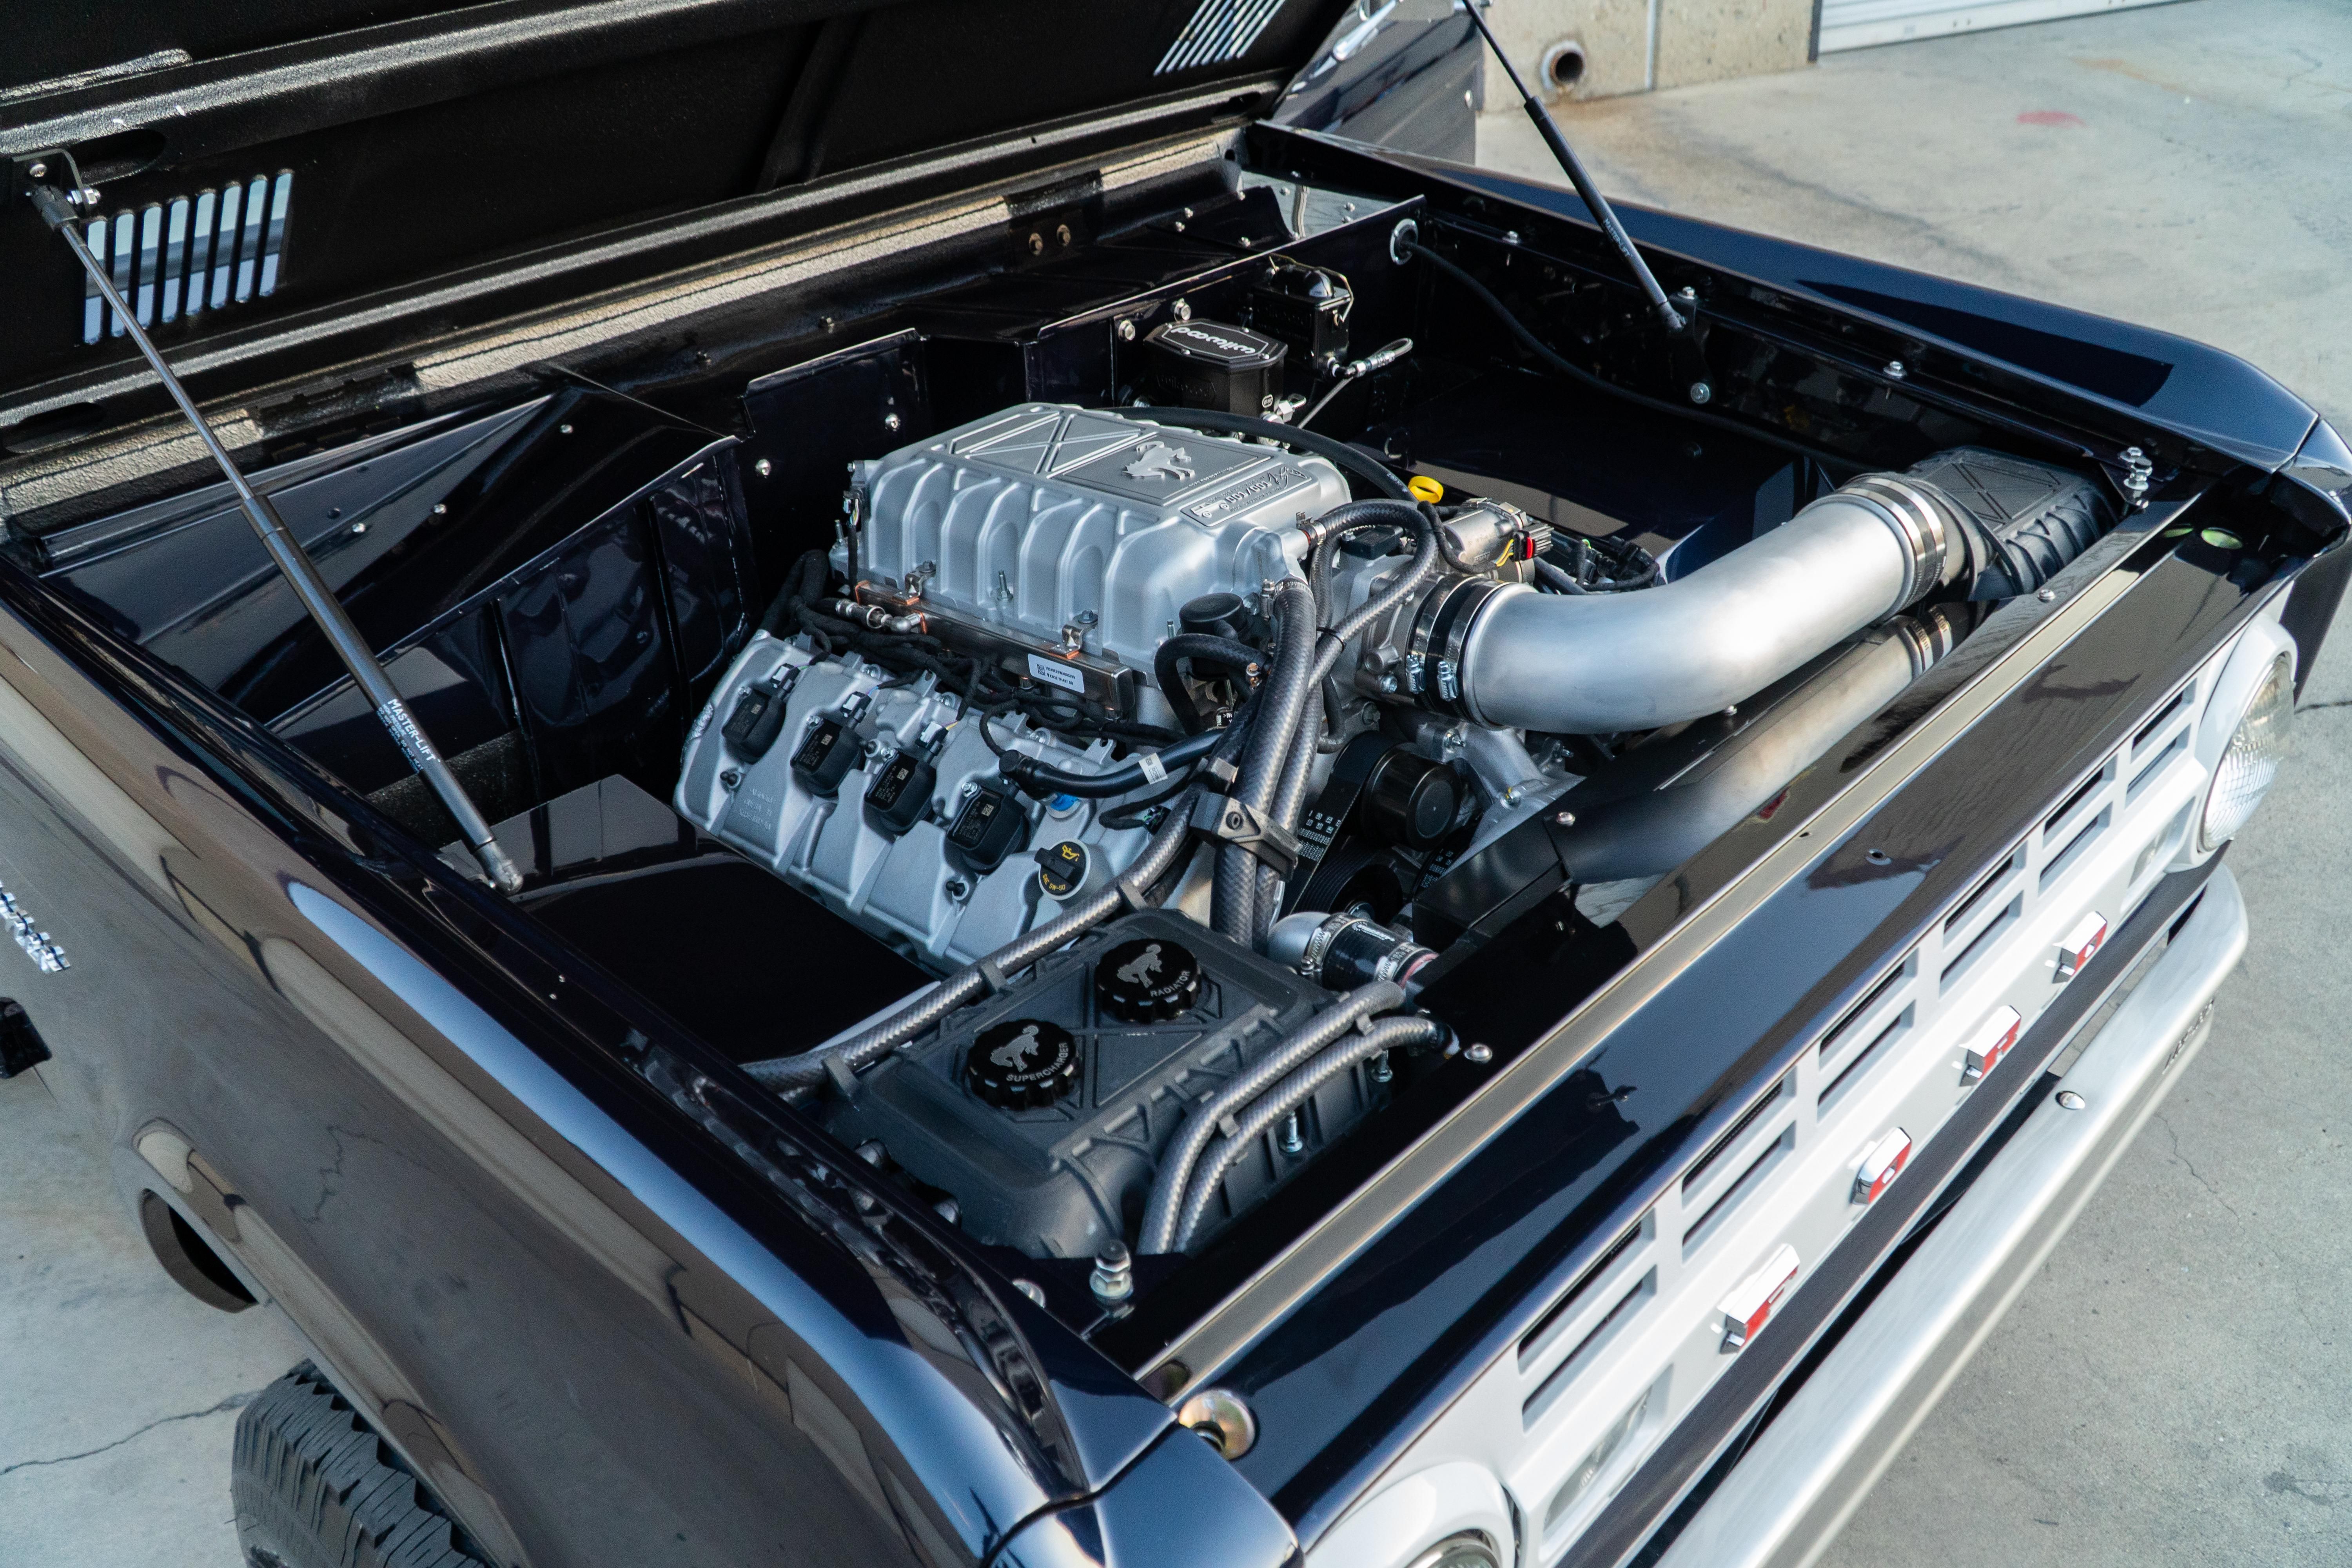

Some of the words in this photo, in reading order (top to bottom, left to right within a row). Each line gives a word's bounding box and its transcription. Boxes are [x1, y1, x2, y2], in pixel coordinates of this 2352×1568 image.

[1171, 327, 1256, 354] wilwood
[1226, 481, 1272, 503] 001/001
[383, 715, 392, 725] NOT
[406, 748, 414, 757] NOT
[388, 699, 436, 761] MASTER-LIFT
[390, 715, 406, 736] PRESSURE
[1049, 883, 1066, 891] 5W-50
[1151, 970, 1191, 998] RADIATOR
[1006, 1042, 1069, 1083] SUPERCHARGER
